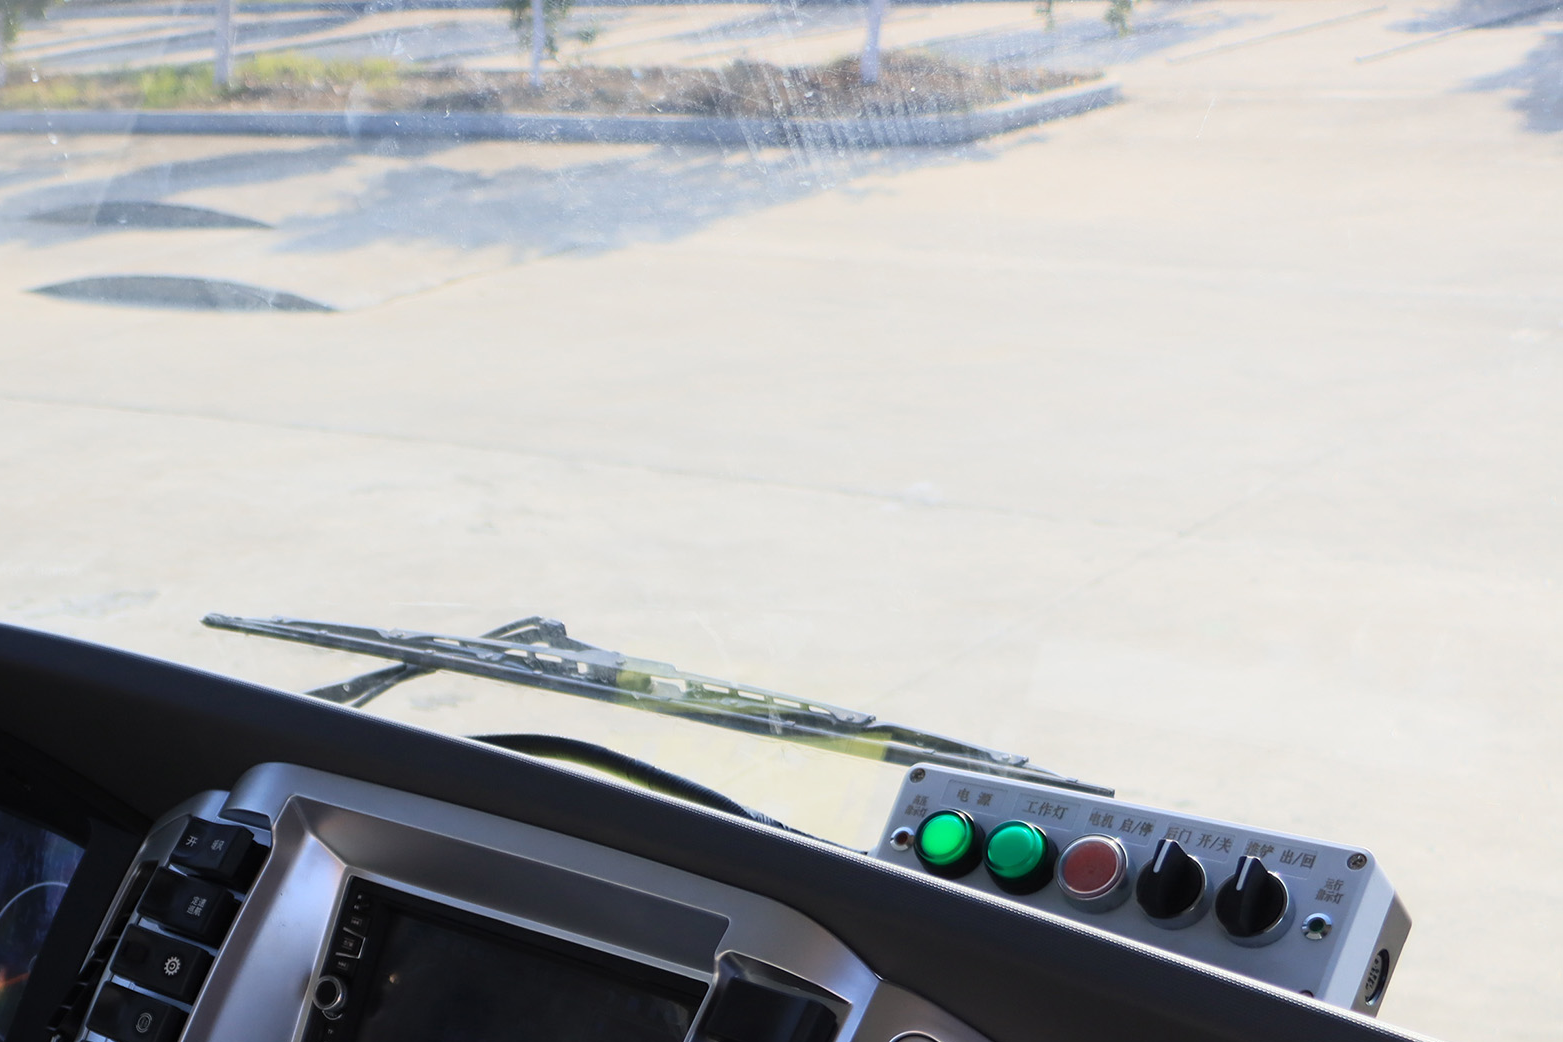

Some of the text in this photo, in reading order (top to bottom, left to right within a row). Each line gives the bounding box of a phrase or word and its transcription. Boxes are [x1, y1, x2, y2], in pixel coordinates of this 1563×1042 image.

[956, 786, 994, 807] 电源
[1022, 801, 1069, 820] 工作灯
[1089, 811, 1153, 837] 电机 启/停
[1163, 826, 1232, 853] 后门 开/关
[1279, 849, 1317, 869] 出/回
